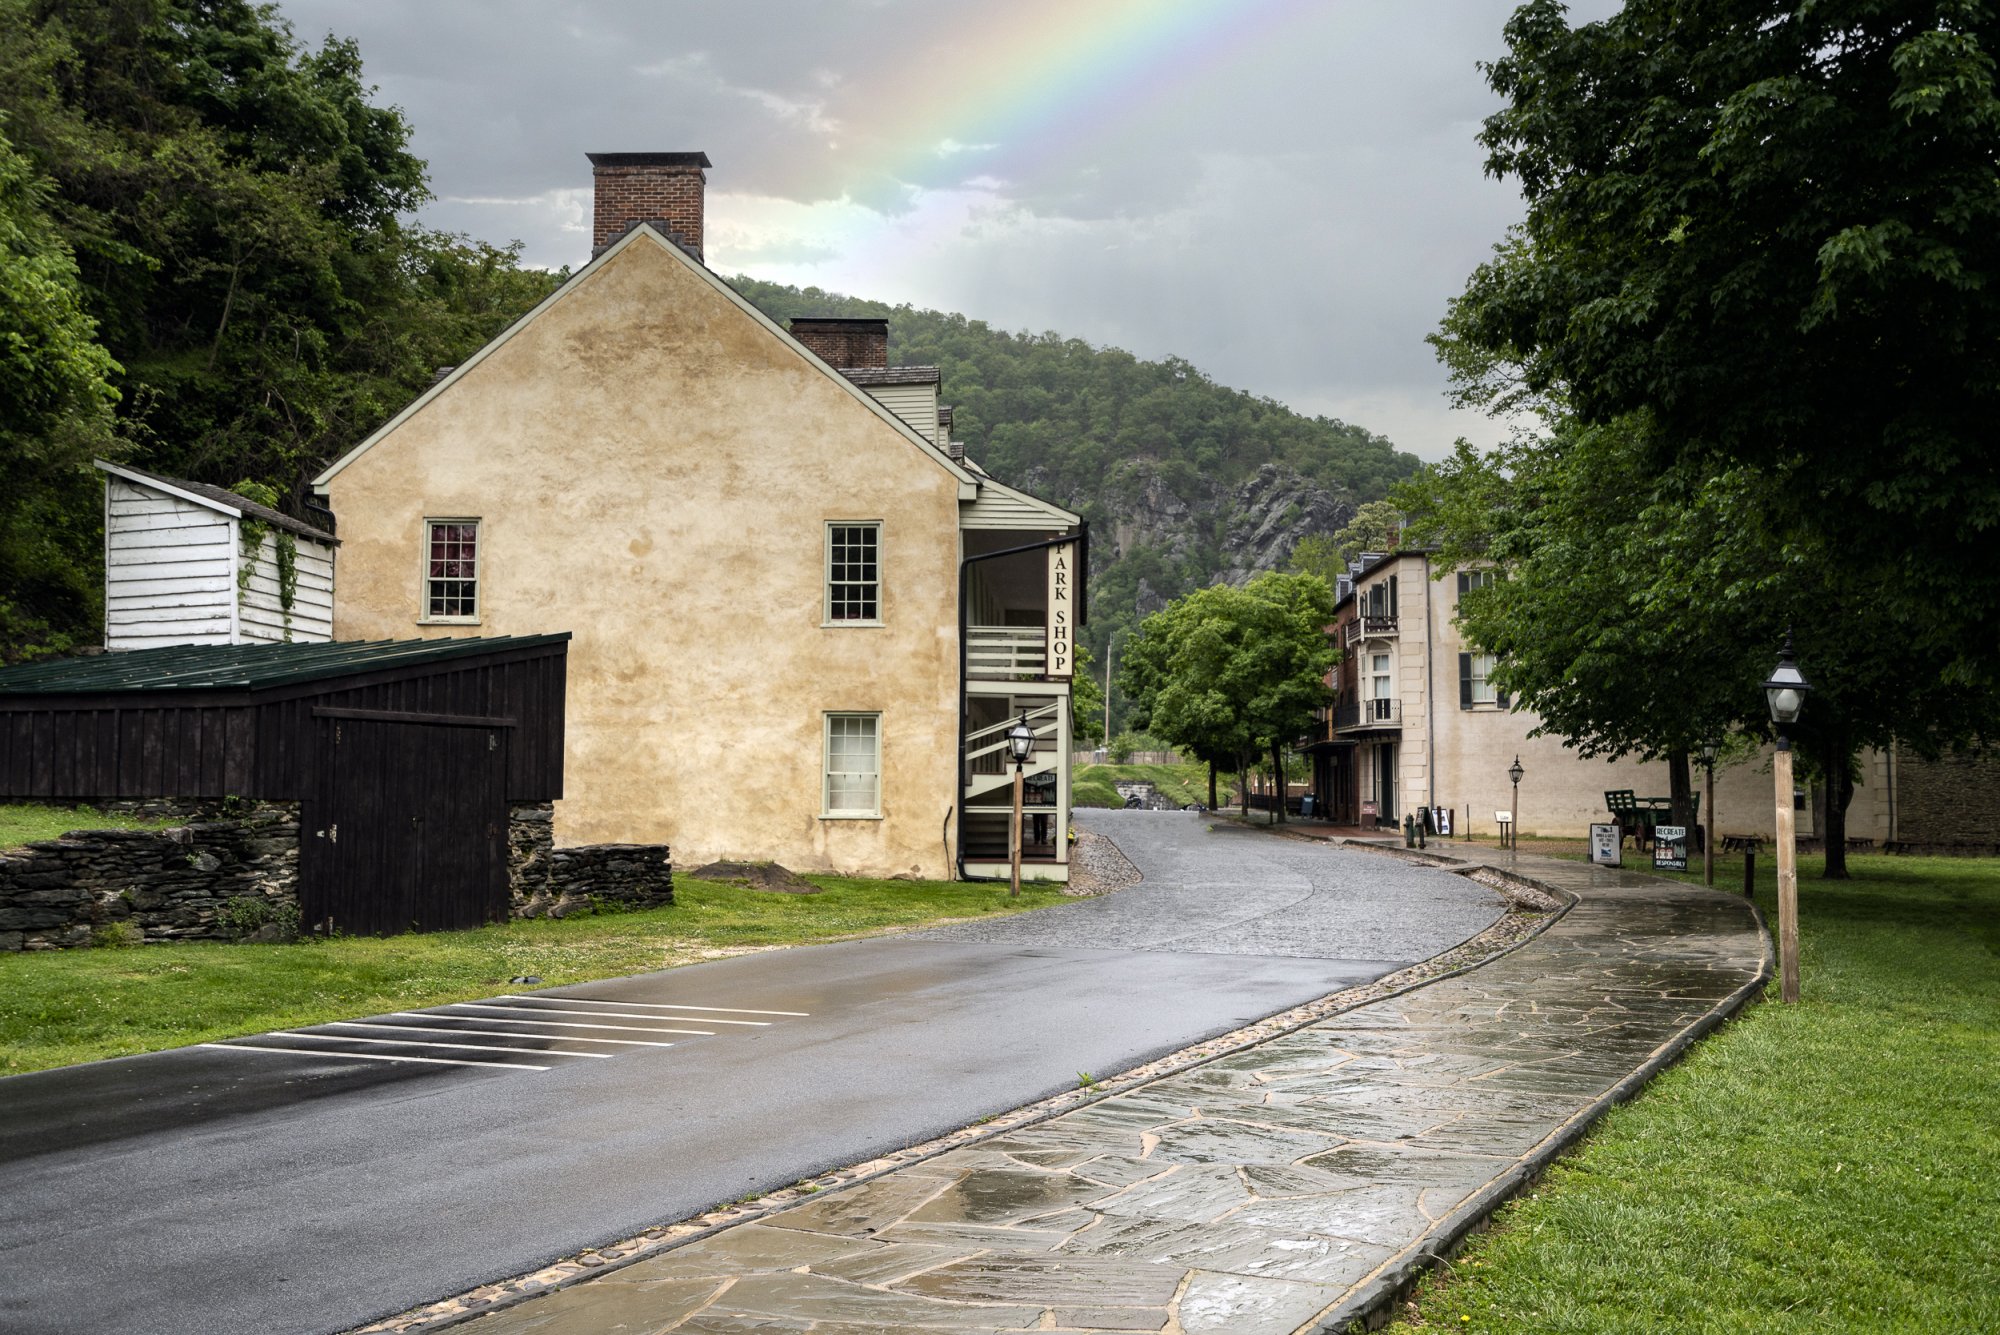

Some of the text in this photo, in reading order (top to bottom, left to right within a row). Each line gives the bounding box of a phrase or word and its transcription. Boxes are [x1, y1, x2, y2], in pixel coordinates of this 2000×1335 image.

[1054, 543, 1067, 670] PARK SHOP
[1656, 828, 1685, 836] RECREATE
